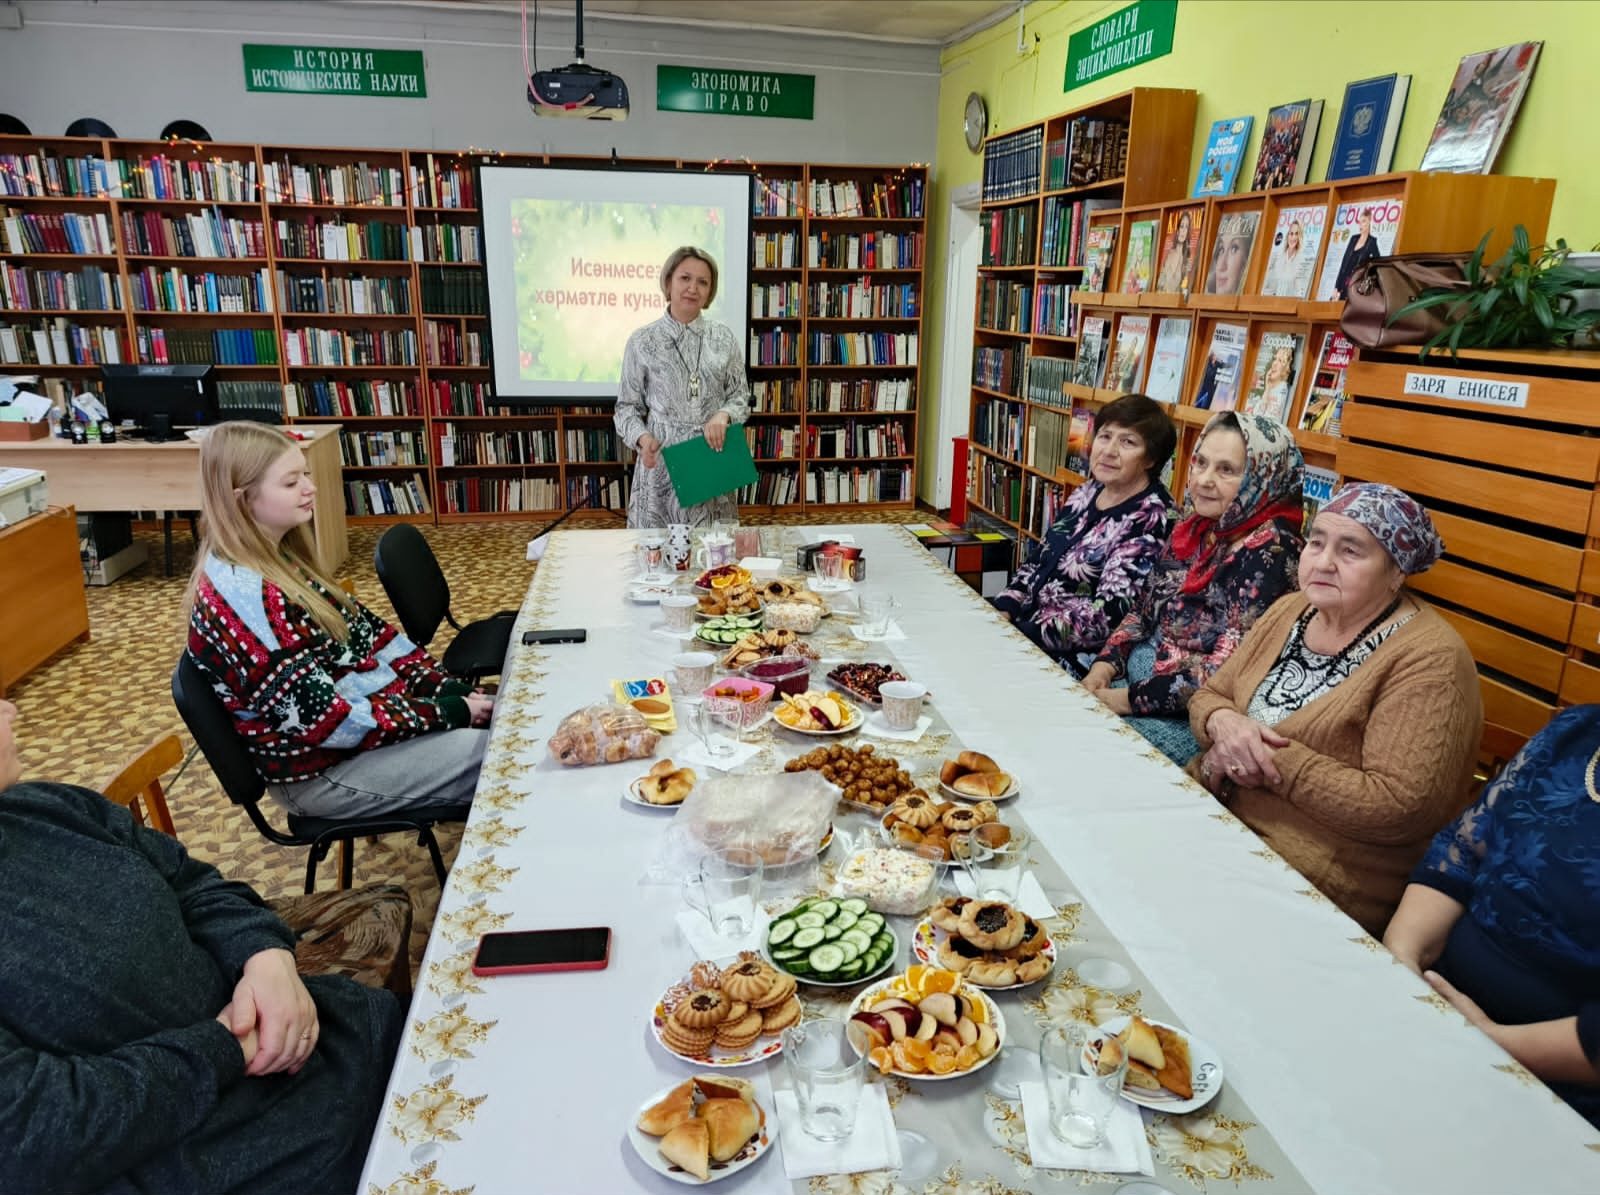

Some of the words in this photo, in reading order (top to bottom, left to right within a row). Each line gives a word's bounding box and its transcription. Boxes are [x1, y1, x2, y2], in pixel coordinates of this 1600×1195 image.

[1091, 7, 1139, 50] СЛОВАРИ
[293, 49, 375, 70] ИСТОРИЯ
[1076, 28, 1154, 81] ЭНЦИКЛОПЕДИИ
[252, 69, 361, 91] ИСТОРИЧЕСКИЕ
[370, 73, 419, 93] НАУКИ
[691, 71, 781, 95] ЭКОНОМИКА
[705, 92, 769, 112] ПРАВО
[535, 289, 617, 310] хөрмәтле
[1411, 376, 1446, 393] ЗАРЯ
[1458, 381, 1519, 401] ЕНИСЕЯ
